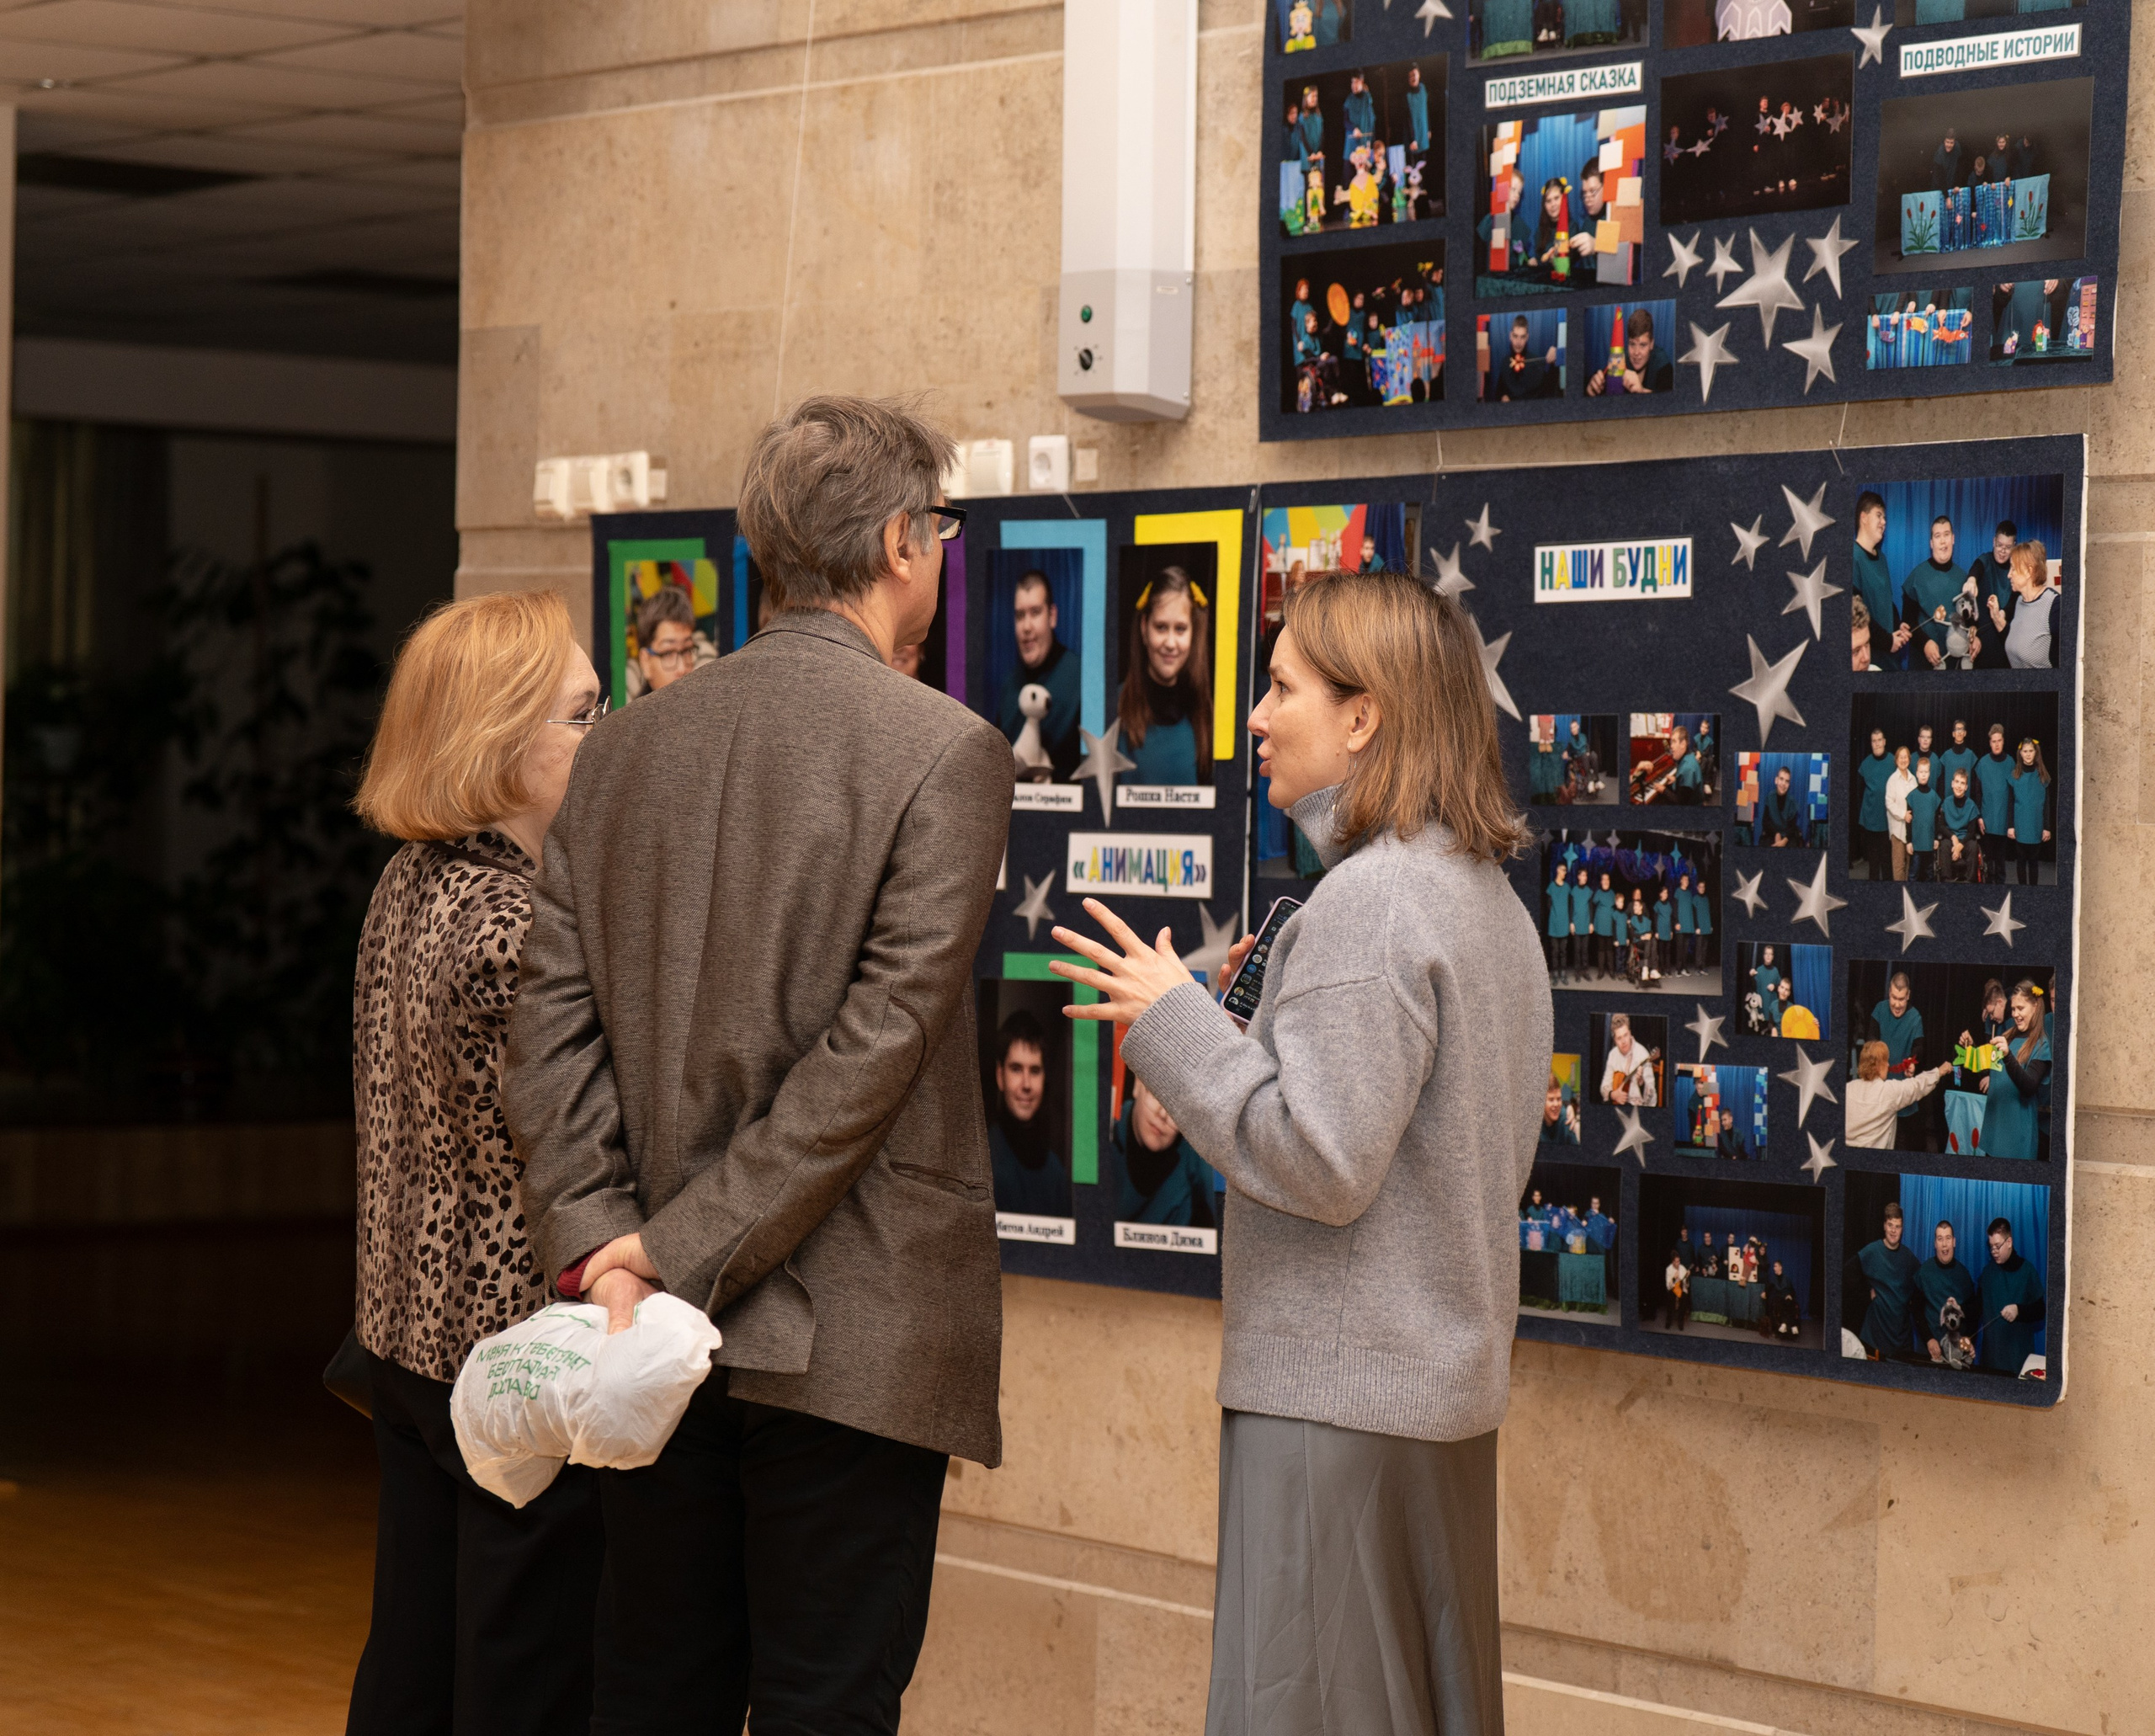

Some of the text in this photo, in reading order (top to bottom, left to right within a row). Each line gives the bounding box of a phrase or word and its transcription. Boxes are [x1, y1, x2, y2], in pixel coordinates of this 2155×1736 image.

[1903, 31, 2075, 72] ПОДВОДНЫЕ ИСТОРИИ
[1489, 67, 1636, 104] ПОДЗЕМНАЯ СКАЗКА
[1540, 545, 1687, 594] НАШИ БУДНИ
[1125, 788, 1200, 803] Рошка Настя
[1122, 1227, 1204, 1249] Блинов Дима
